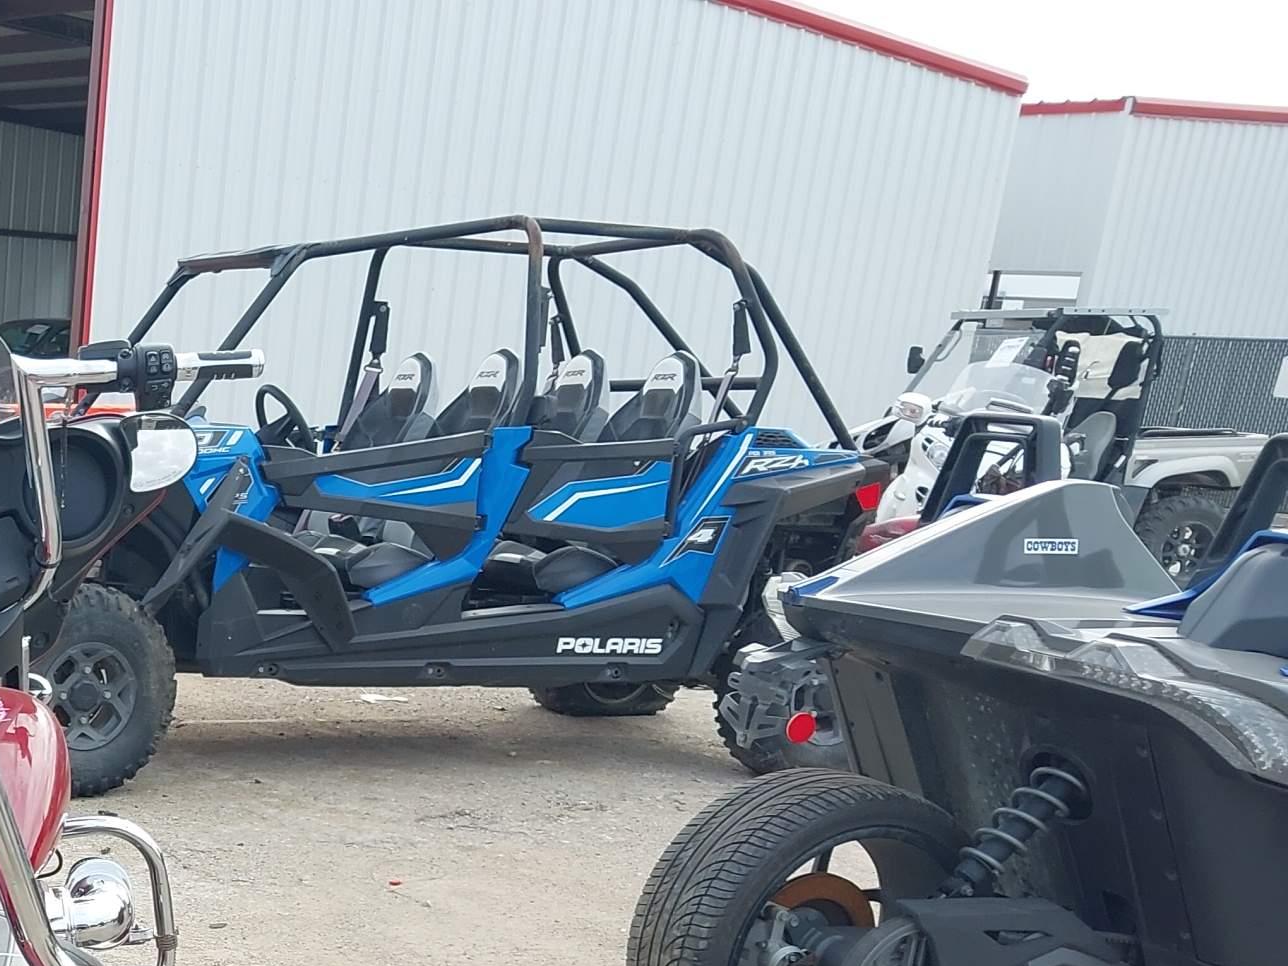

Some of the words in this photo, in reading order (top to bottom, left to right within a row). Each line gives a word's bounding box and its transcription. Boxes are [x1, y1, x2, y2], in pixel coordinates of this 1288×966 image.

[687, 528, 716, 543] 4
[1026, 541, 1076, 551] COWBOYS
[556, 637, 663, 654] POLARIS
